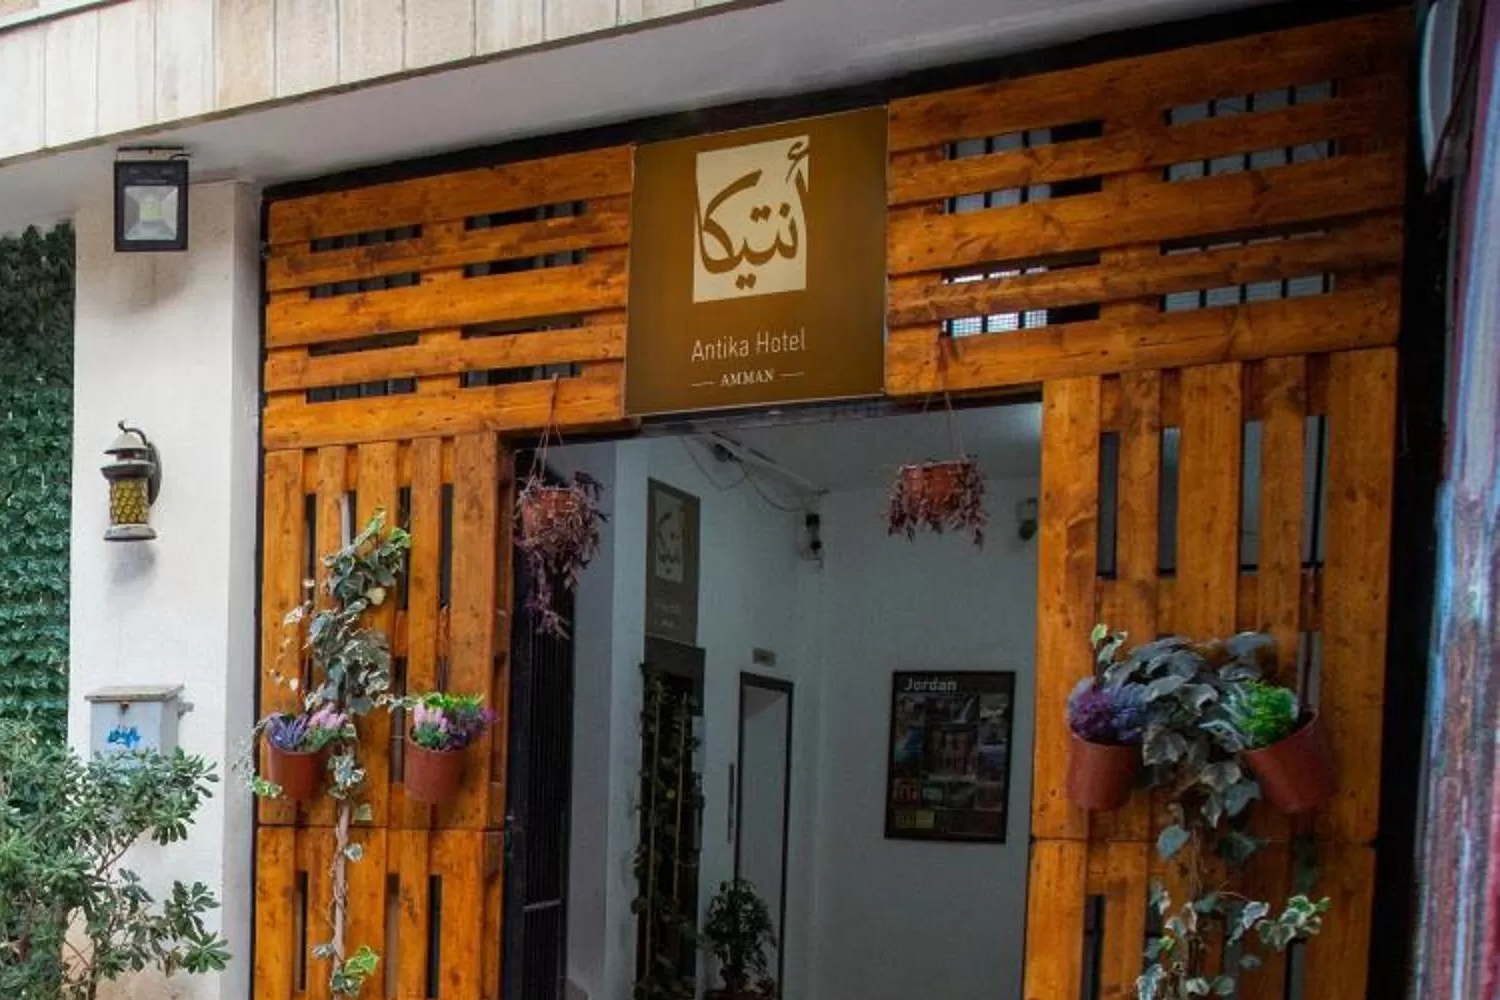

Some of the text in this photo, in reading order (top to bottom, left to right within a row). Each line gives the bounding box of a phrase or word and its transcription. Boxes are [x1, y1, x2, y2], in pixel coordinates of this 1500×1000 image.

[691, 327, 804, 363] Antika Hotel
[721, 368, 774, 387] AMMAN
[904, 676, 958, 692] Jordan
